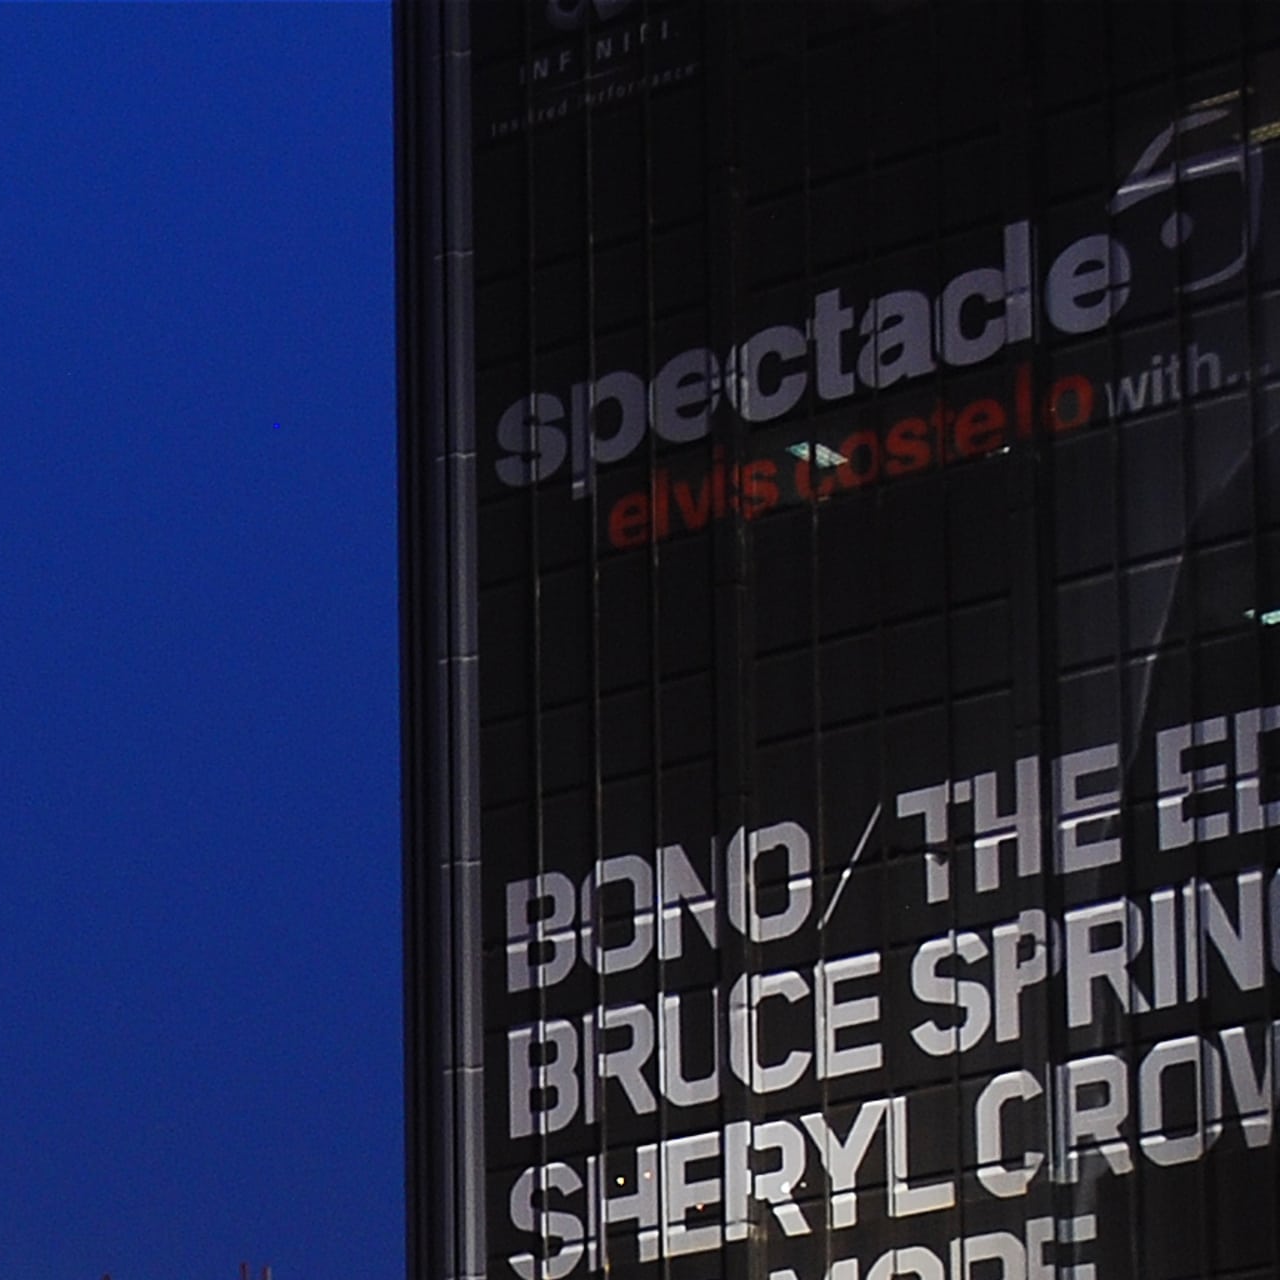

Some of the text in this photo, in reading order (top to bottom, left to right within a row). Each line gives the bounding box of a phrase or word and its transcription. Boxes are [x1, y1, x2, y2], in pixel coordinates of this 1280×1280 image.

[495, 219, 1132, 500] spectacle
[607, 443, 780, 551] elvis
[795, 363, 1095, 497] costelo
[506, 820, 813, 994] BONO
[896, 742, 1123, 904] THE
[507, 867, 1280, 1138] BRUCE SPRIN
